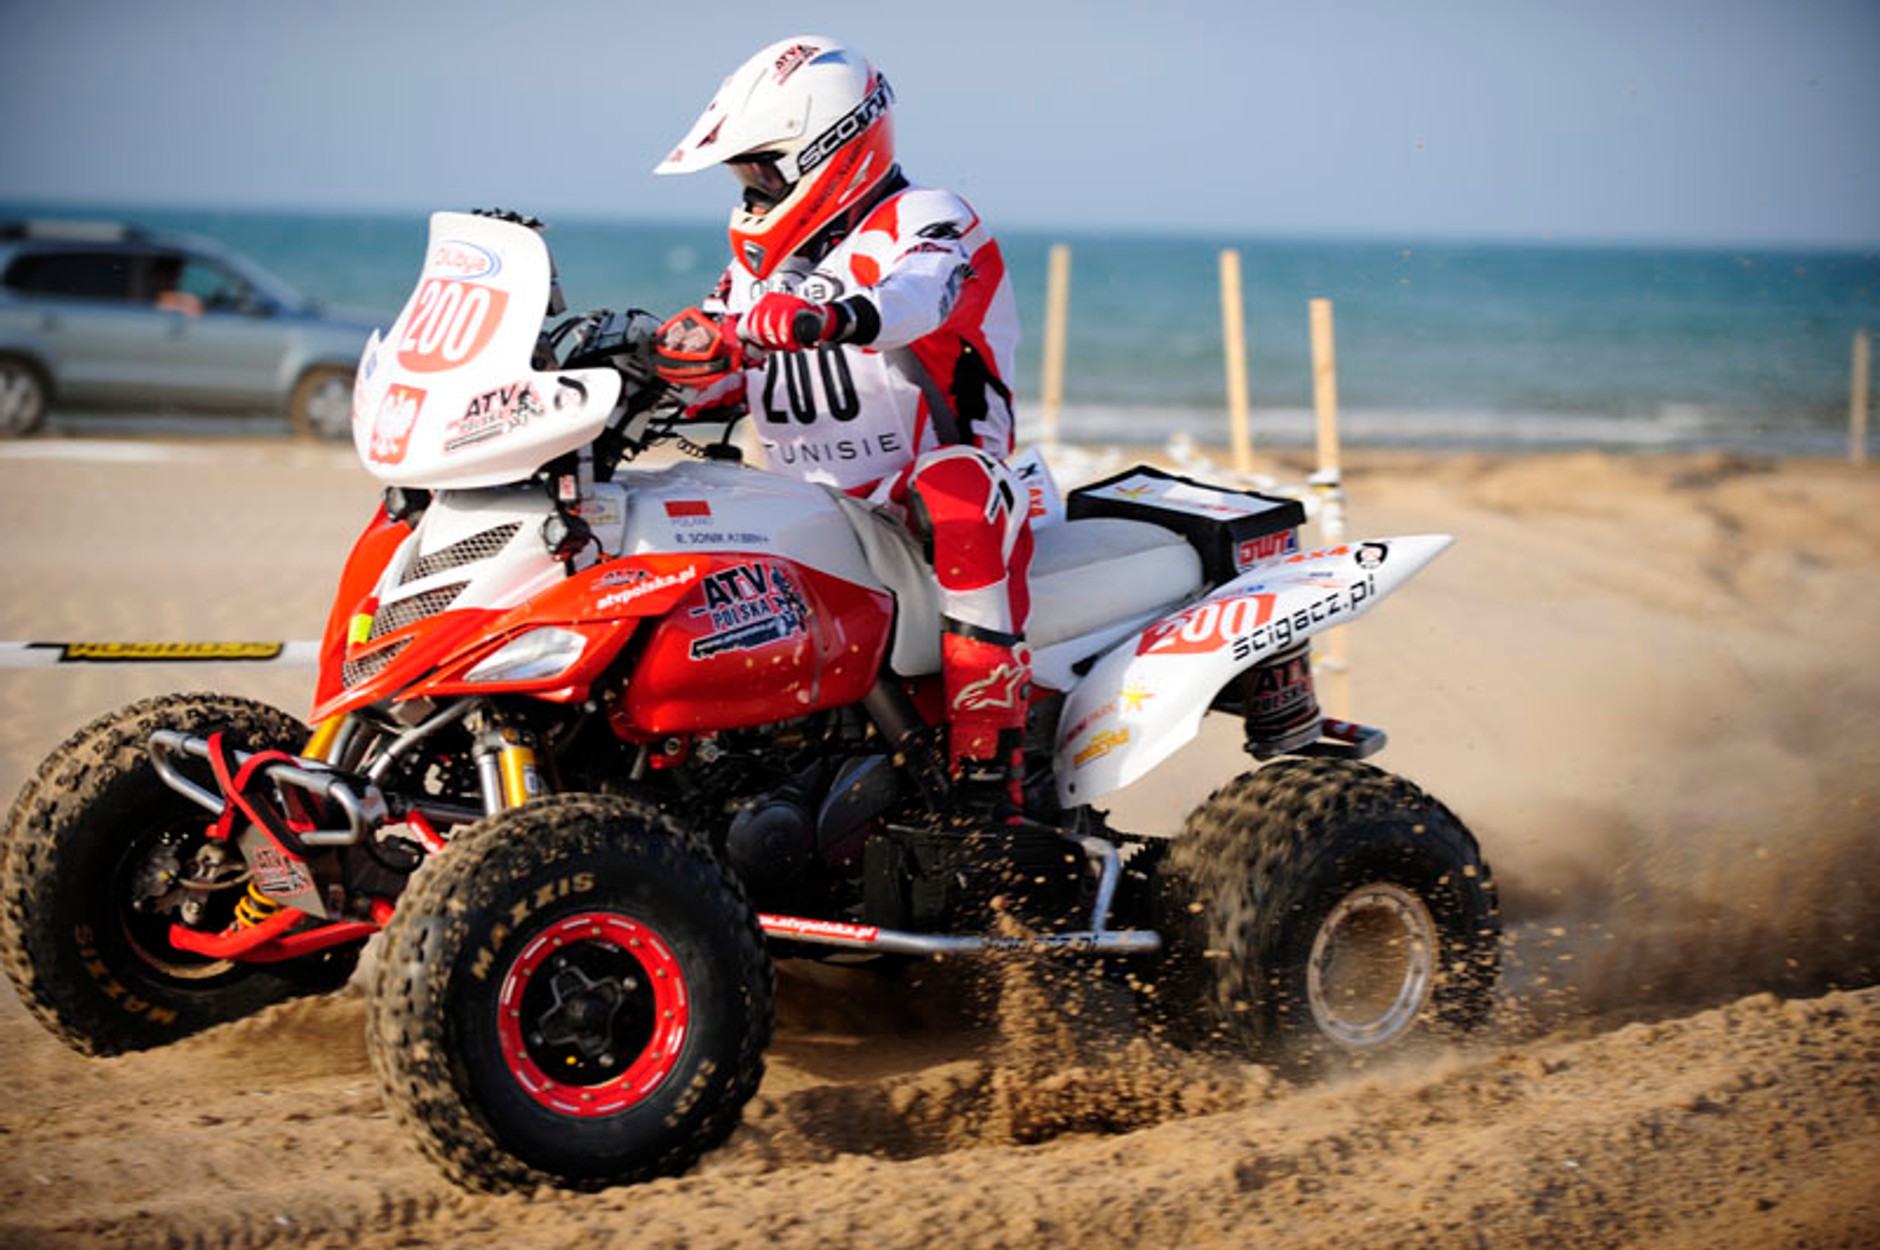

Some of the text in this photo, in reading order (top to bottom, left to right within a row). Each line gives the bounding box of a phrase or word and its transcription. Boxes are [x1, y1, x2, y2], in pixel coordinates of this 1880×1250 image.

[400, 281, 491, 362] 200
[463, 383, 518, 420] ATV
[762, 342, 860, 425] 200
[763, 433, 901, 465] TUNISIE
[597, 565, 697, 609] atvpolska.pl
[703, 563, 768, 609] ATV
[712, 599, 772, 629] POLSKA
[1146, 597, 1259, 652] 200
[471, 871, 596, 980] MAXXIS
